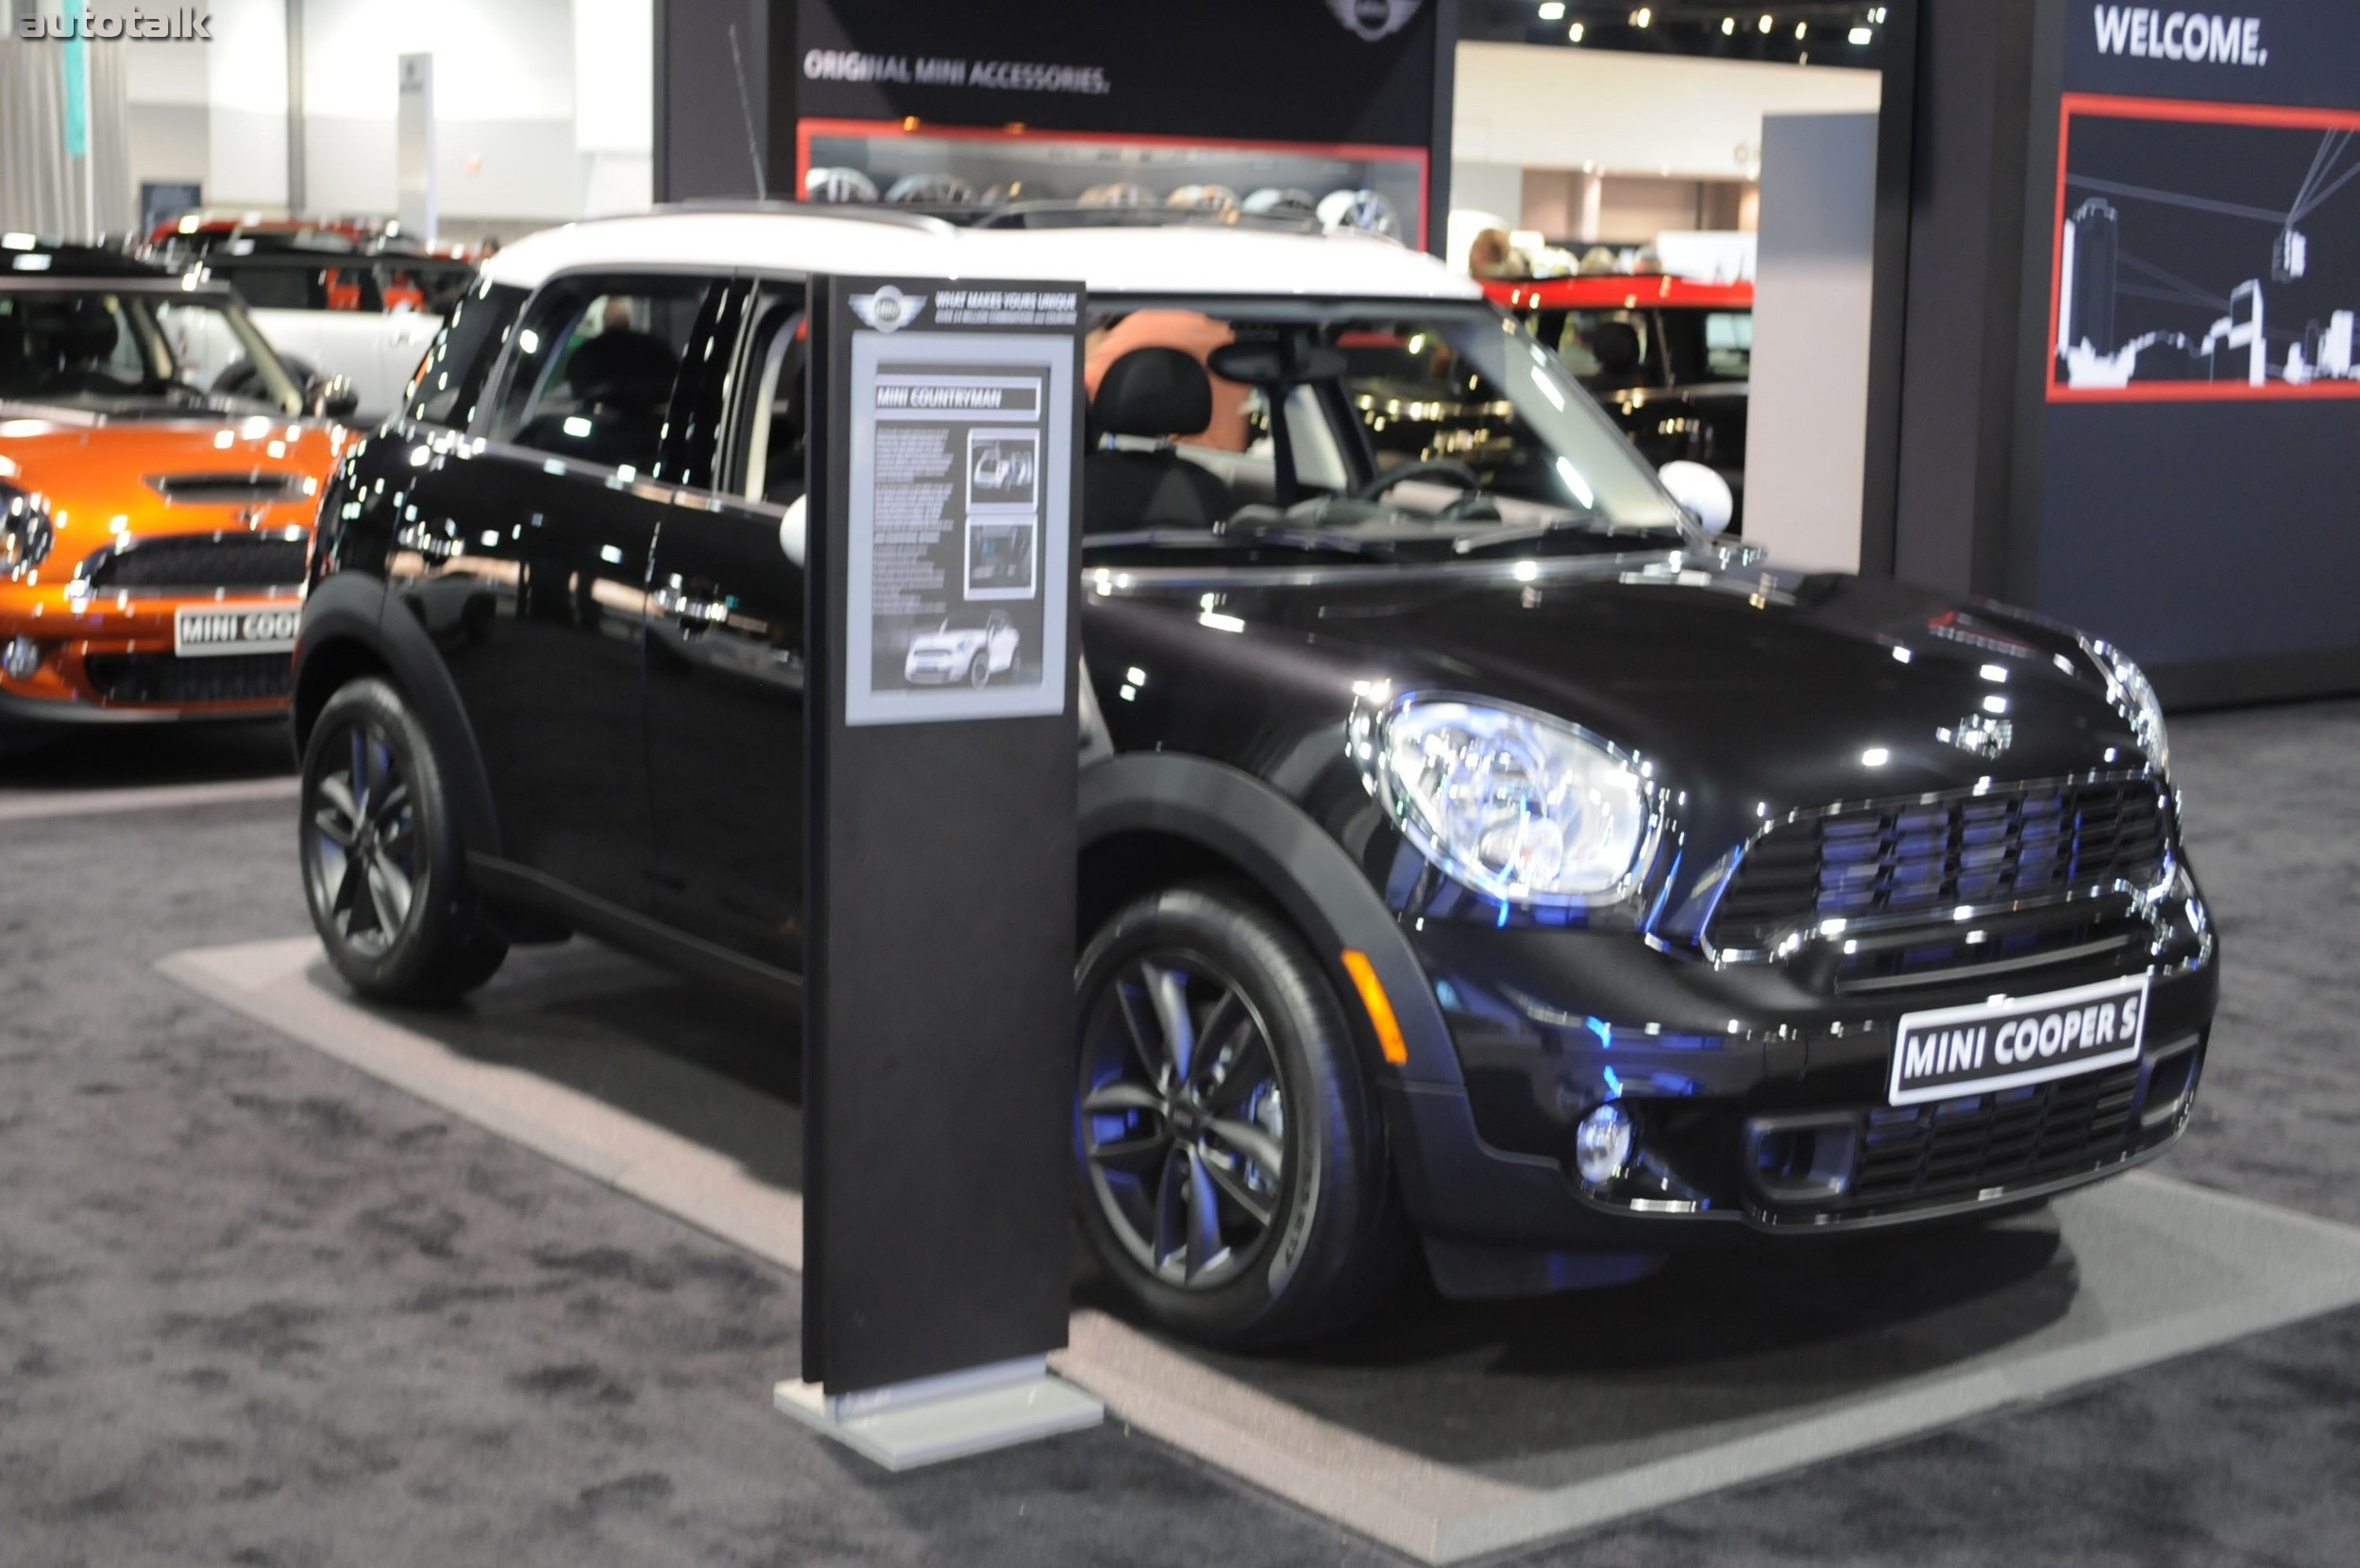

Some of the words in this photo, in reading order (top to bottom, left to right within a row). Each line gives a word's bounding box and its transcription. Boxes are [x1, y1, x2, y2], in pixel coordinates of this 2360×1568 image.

[2093, 4, 2268, 67] WELCOME.
[802, 48, 911, 83] ORIGINAL
[876, 386, 908, 408] MINI
[909, 386, 1003, 409] COUNTRYMAN
[182, 615, 238, 642] MINI
[1903, 1025, 1987, 1079] MINI
[1994, 1001, 2116, 1066] COOPER
[2118, 996, 2140, 1040] S
